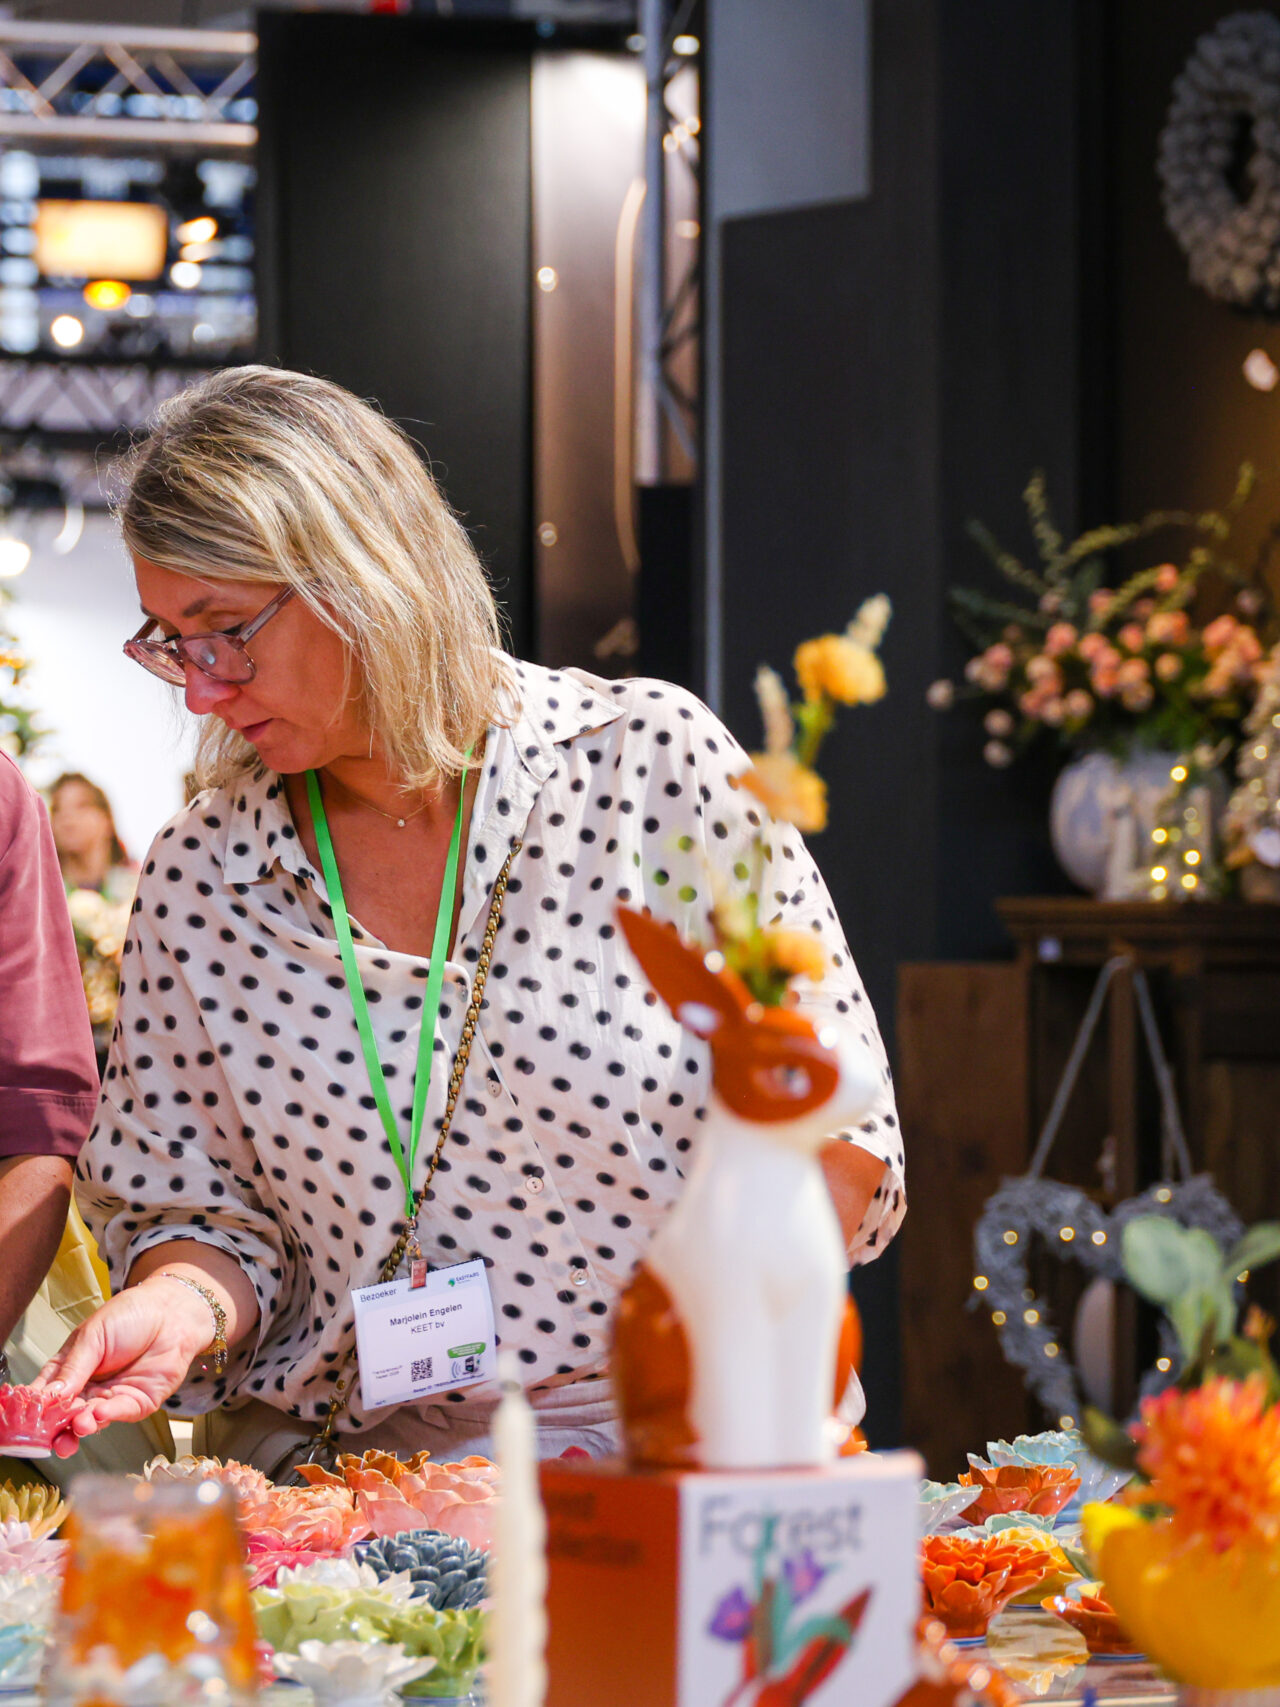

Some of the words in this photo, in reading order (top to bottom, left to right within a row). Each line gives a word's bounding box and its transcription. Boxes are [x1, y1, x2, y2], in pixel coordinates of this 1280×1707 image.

[360, 1288, 397, 1303] Bezoeker
[389, 1311, 428, 1327] Marjolein
[429, 1303, 463, 1317] Engelen
[410, 1322, 433, 1334] KEET
[435, 1320, 446, 1329] bv
